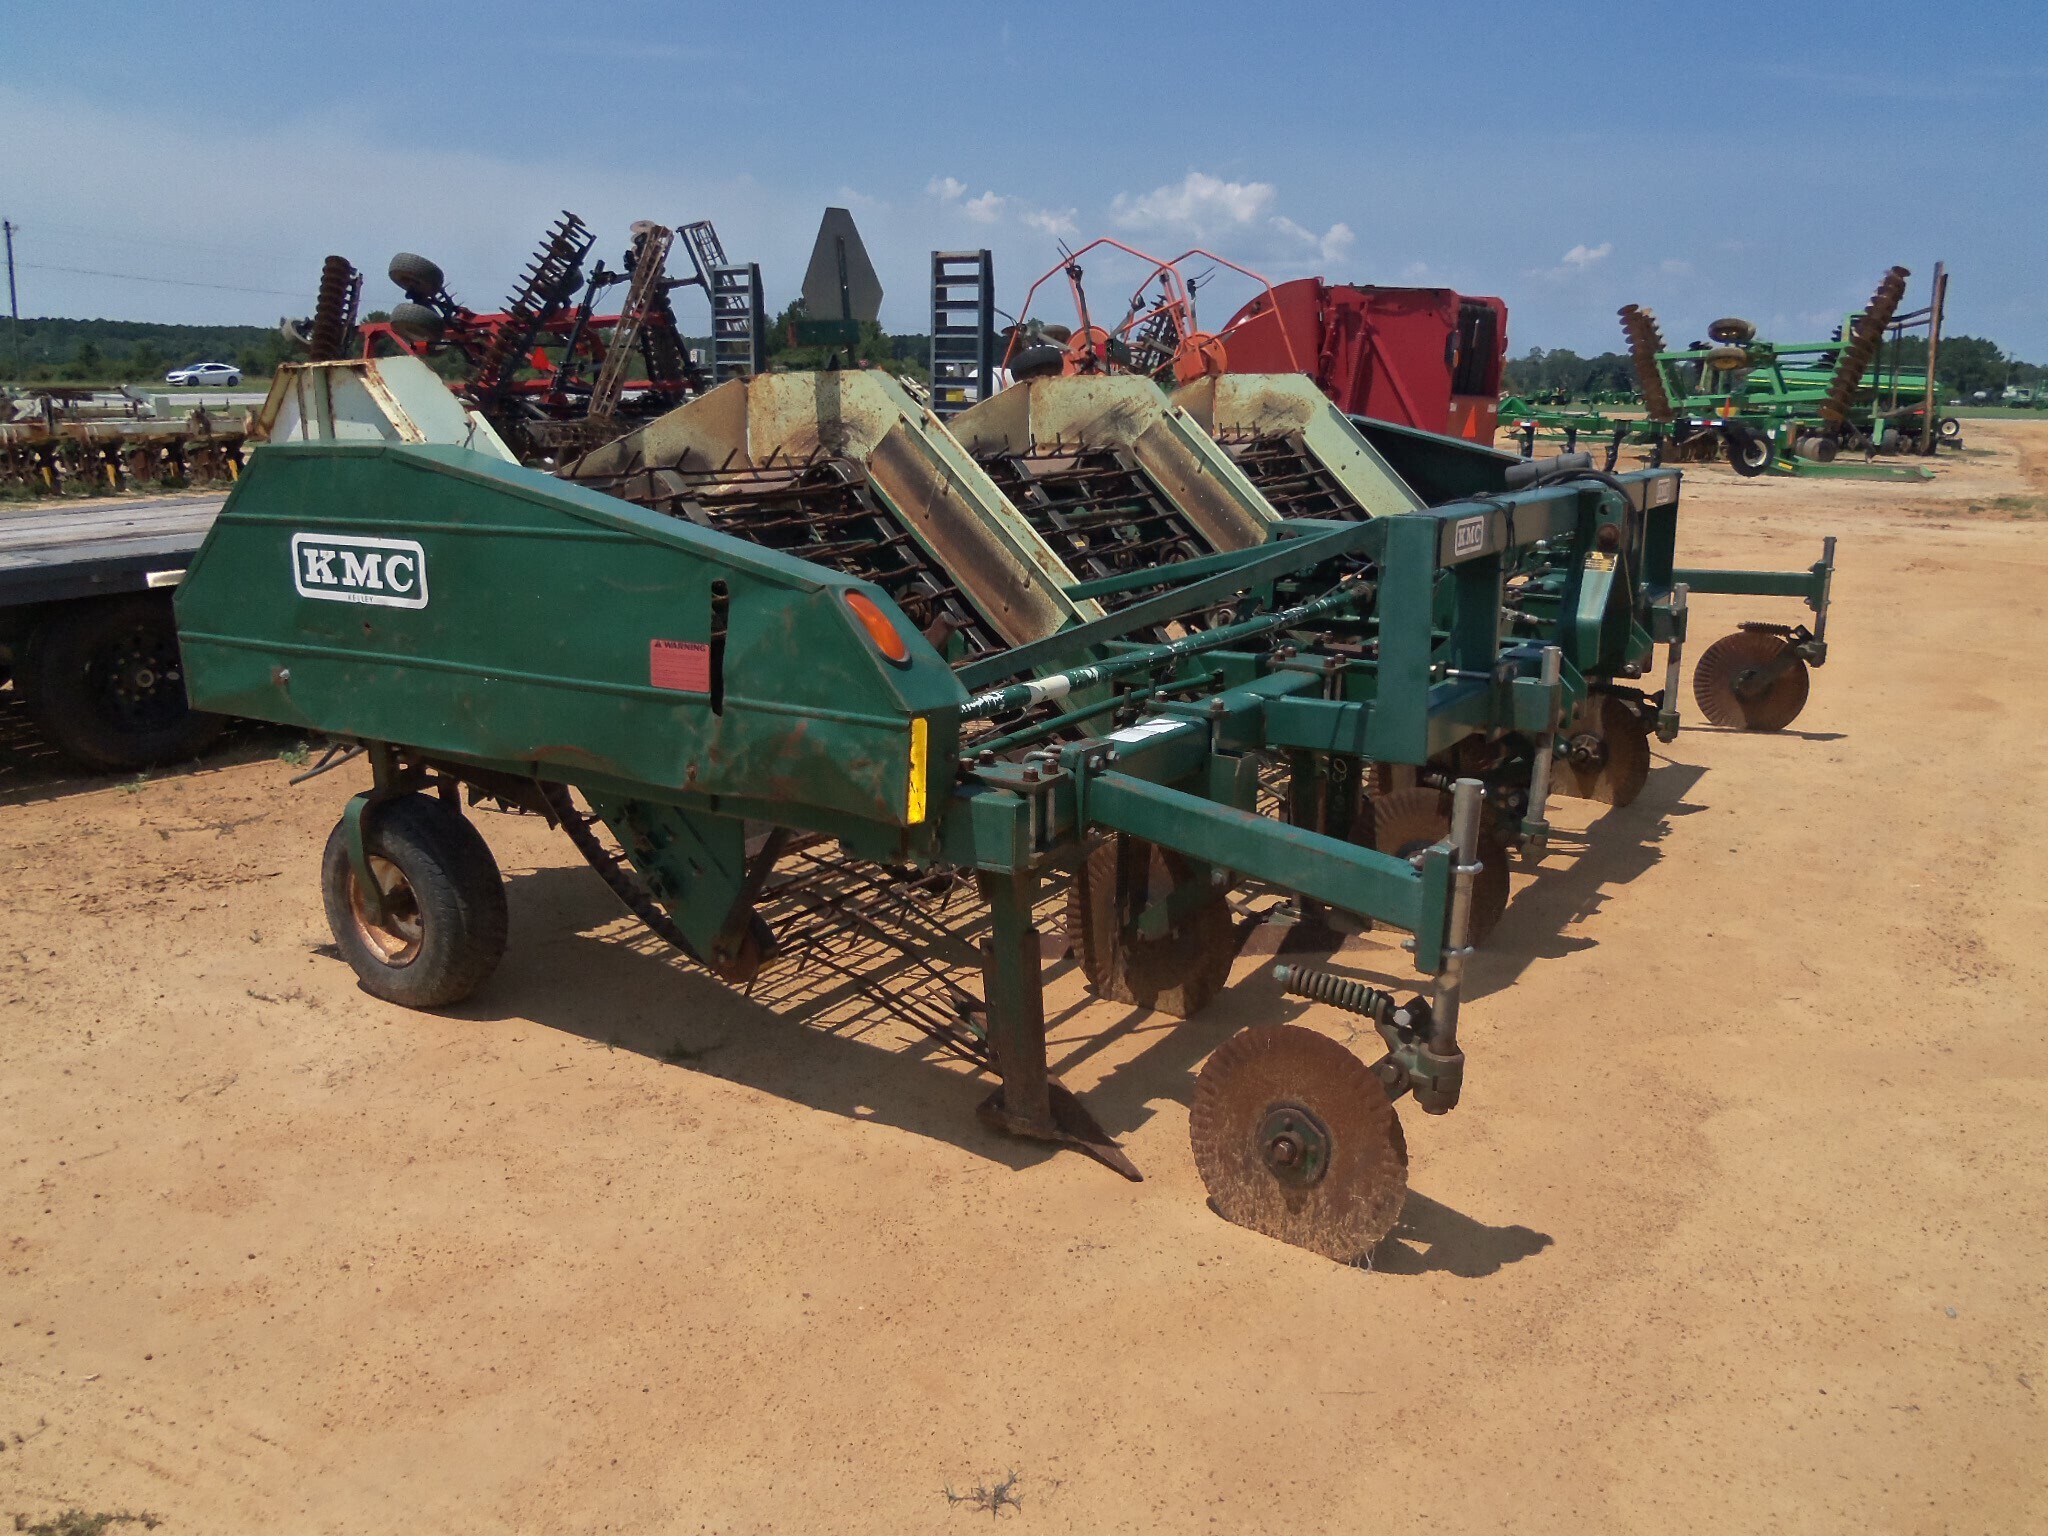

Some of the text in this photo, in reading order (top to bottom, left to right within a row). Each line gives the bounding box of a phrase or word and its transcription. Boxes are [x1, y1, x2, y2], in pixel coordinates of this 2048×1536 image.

[1457, 524, 1482, 547] KMC
[303, 548, 414, 592] KMC
[664, 641, 706, 651] WARNING
